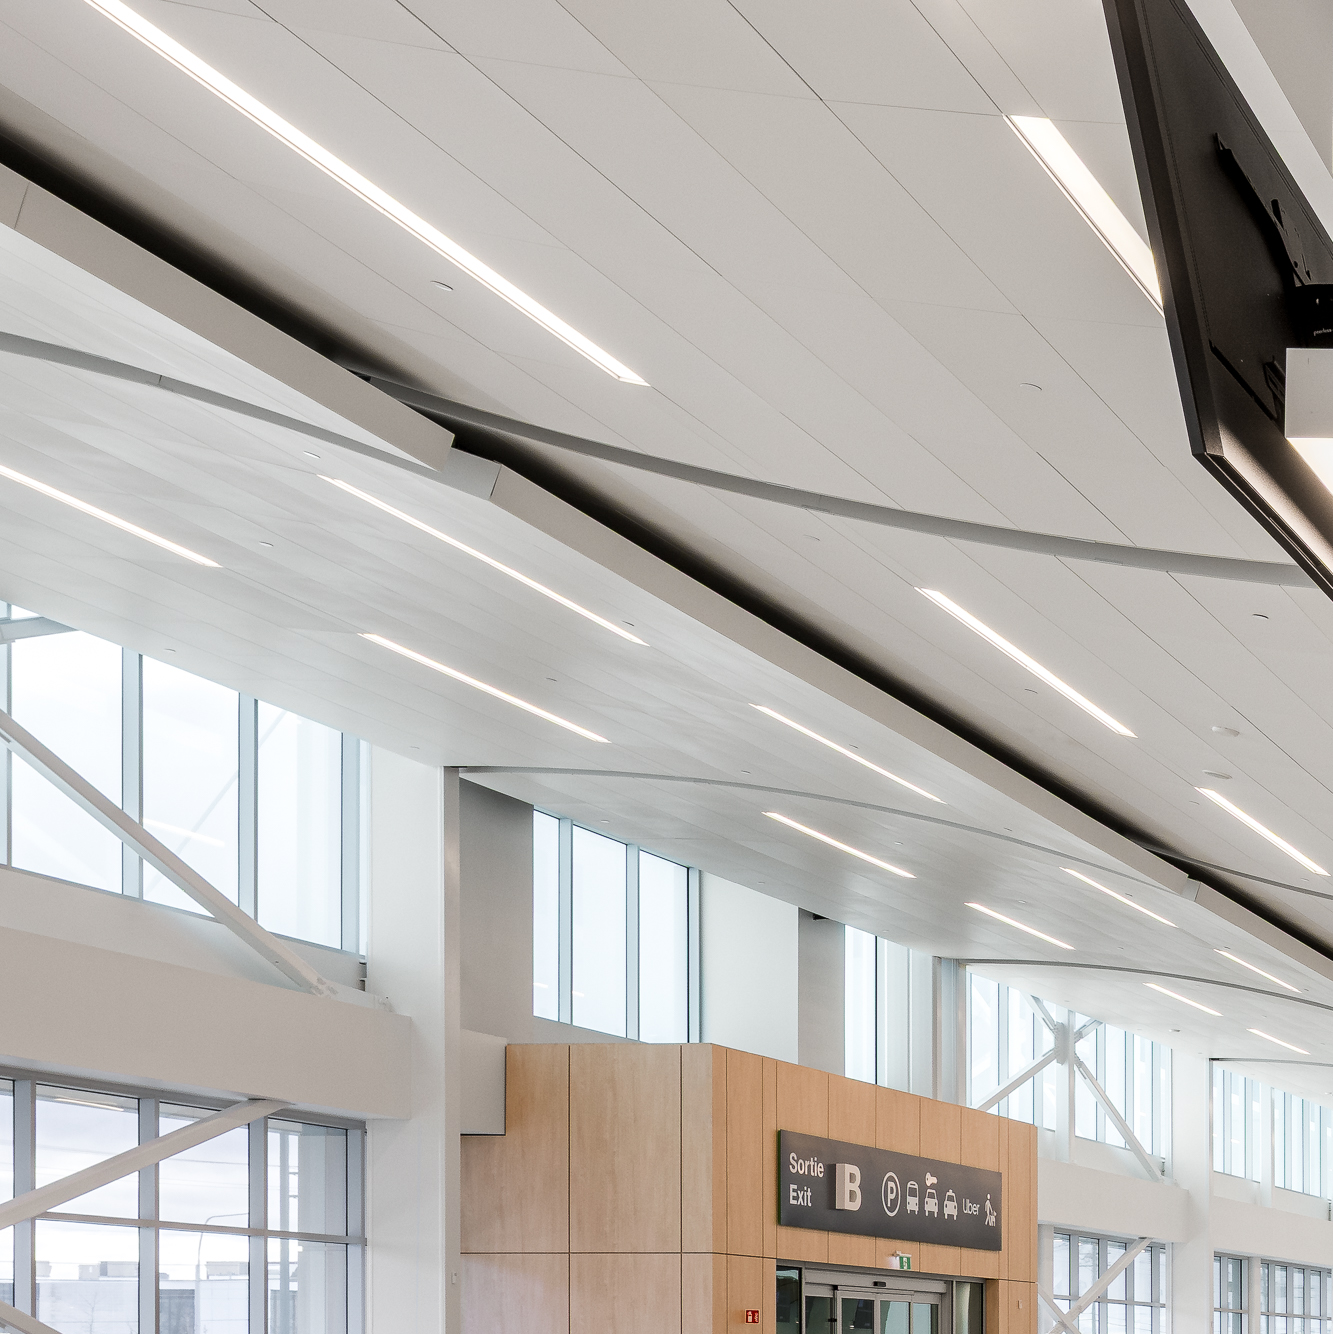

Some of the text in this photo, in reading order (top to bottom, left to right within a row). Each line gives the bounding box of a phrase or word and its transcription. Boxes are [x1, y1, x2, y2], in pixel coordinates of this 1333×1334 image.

[789, 1152, 824, 1178] Sortie
[789, 1184, 812, 1207] Exit
[835, 1163, 862, 1211] B
[962, 1198, 980, 1216] Uber
